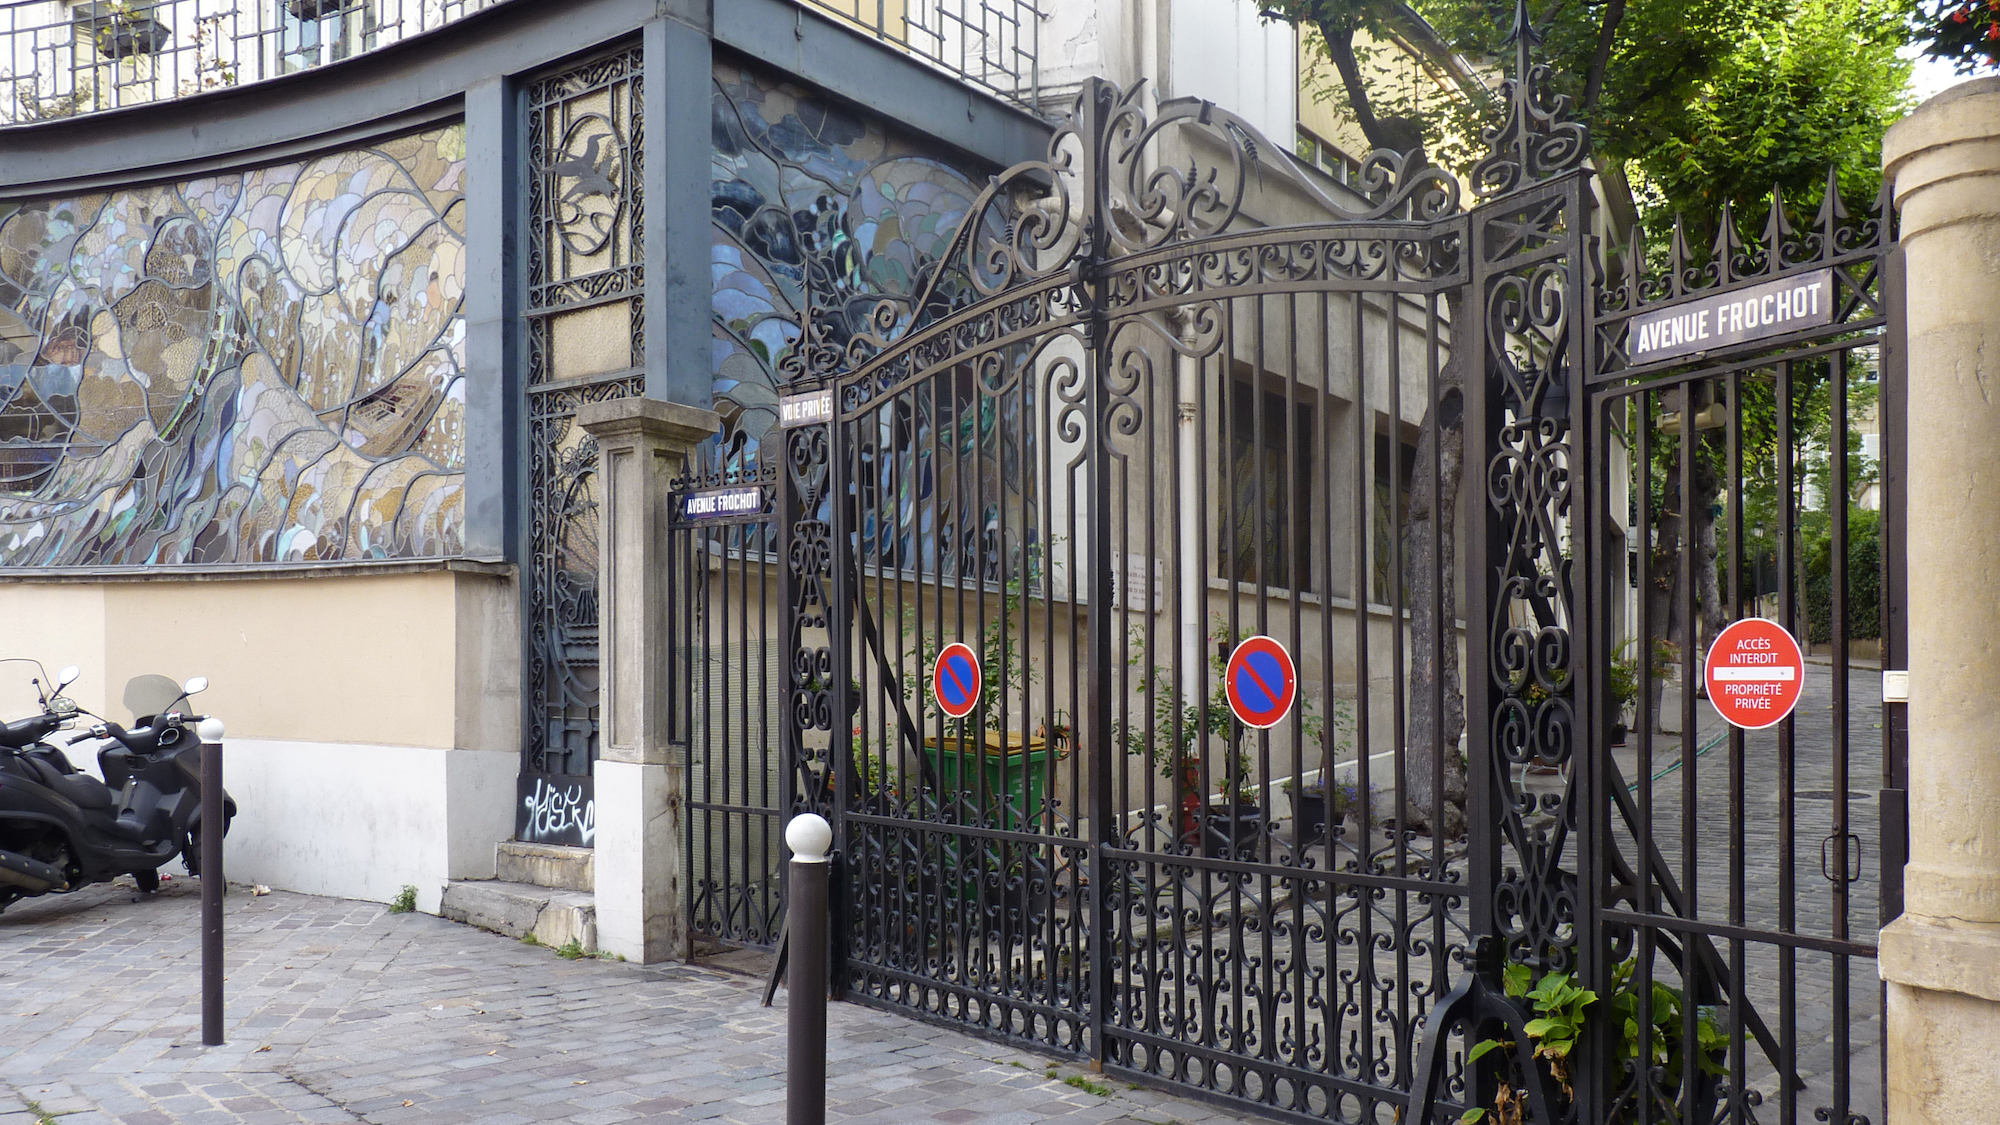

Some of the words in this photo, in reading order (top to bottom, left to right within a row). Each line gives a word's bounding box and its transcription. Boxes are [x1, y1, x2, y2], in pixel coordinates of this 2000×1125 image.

[1637, 309, 1710, 354] AVENUE
[1717, 282, 1822, 335] FROCHOT
[802, 396, 831, 418] PRIVÉE
[687, 496, 716, 515] AVENUE
[717, 492, 758, 512] FROCHOT
[1736, 637, 1771, 650] ACCÈS
[1729, 652, 1779, 664] INTERDIT
[1725, 682, 1782, 695] PROPRIÉTÉ
[1735, 696, 1771, 709] PRIVÉE
